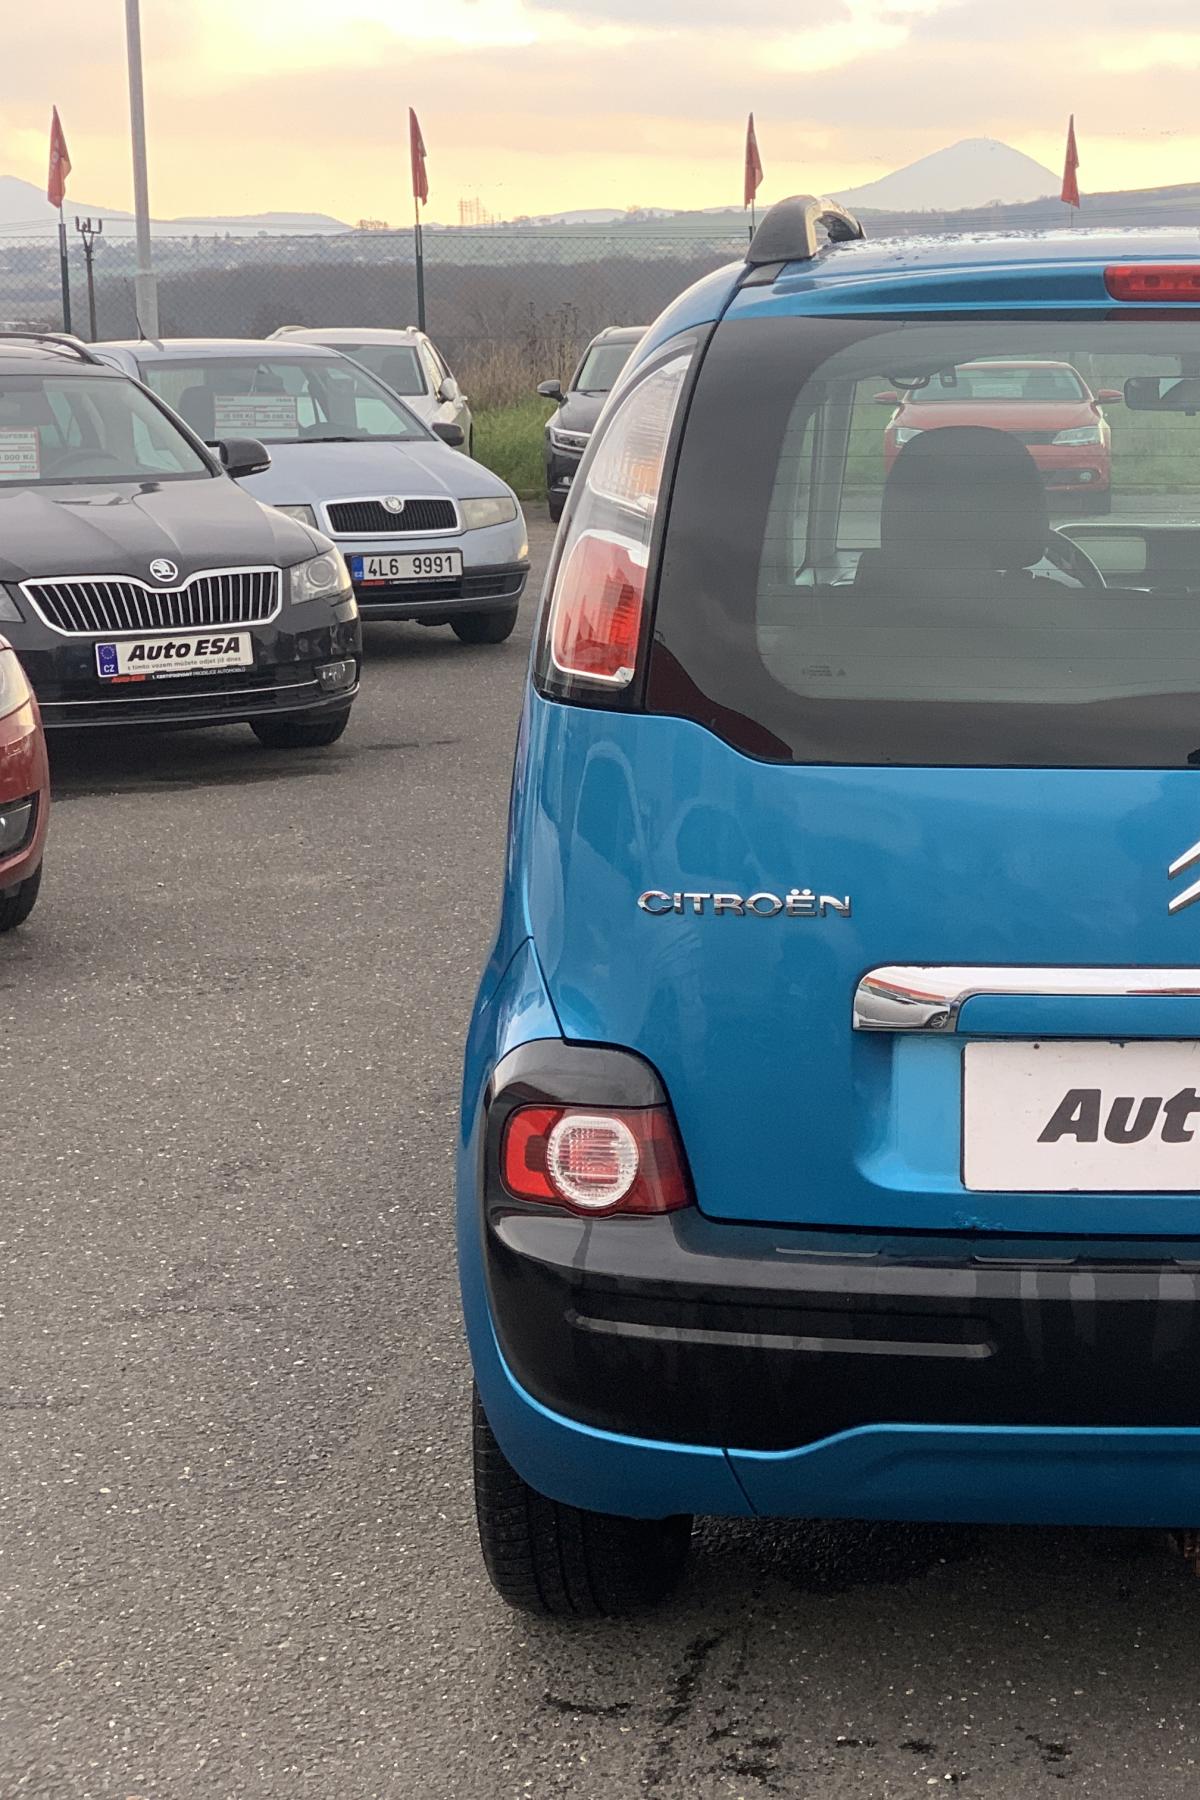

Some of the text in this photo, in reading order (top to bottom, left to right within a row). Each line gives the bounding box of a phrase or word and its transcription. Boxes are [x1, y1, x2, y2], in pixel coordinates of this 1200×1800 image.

[368, 555, 453, 576] 4L6 9991
[127, 637, 240, 662] Auto ESA
[104, 664, 115, 673] CZ
[152, 661, 173, 669] vozem
[199, 657, 216, 666] odjet
[637, 888, 852, 918] CITROËN
